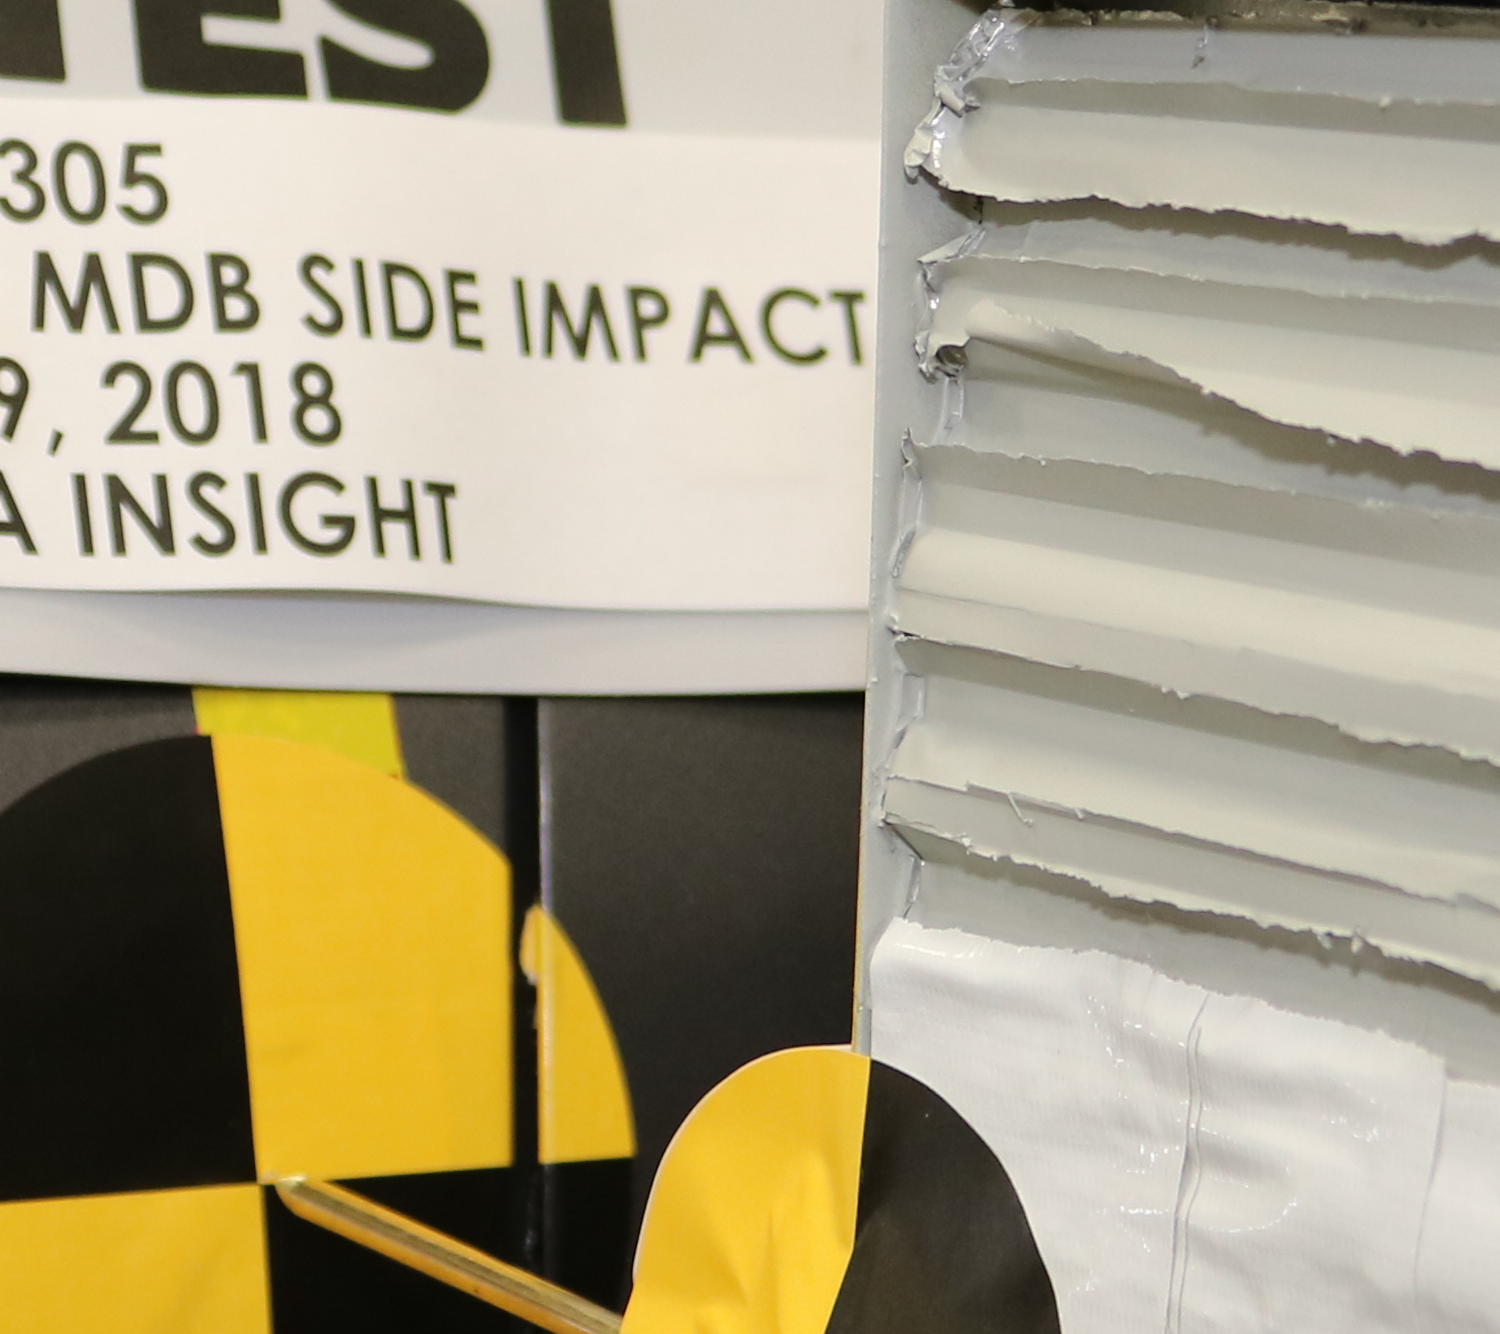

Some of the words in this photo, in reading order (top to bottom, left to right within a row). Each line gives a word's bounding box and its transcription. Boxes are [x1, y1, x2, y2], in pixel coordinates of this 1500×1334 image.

[33, 250, 262, 333] MDB
[299, 253, 486, 351] SIDE
[512, 277, 866, 365] IMPACT
[102, 359, 344, 446] 2018
[73, 472, 458, 564] INSIGHT
